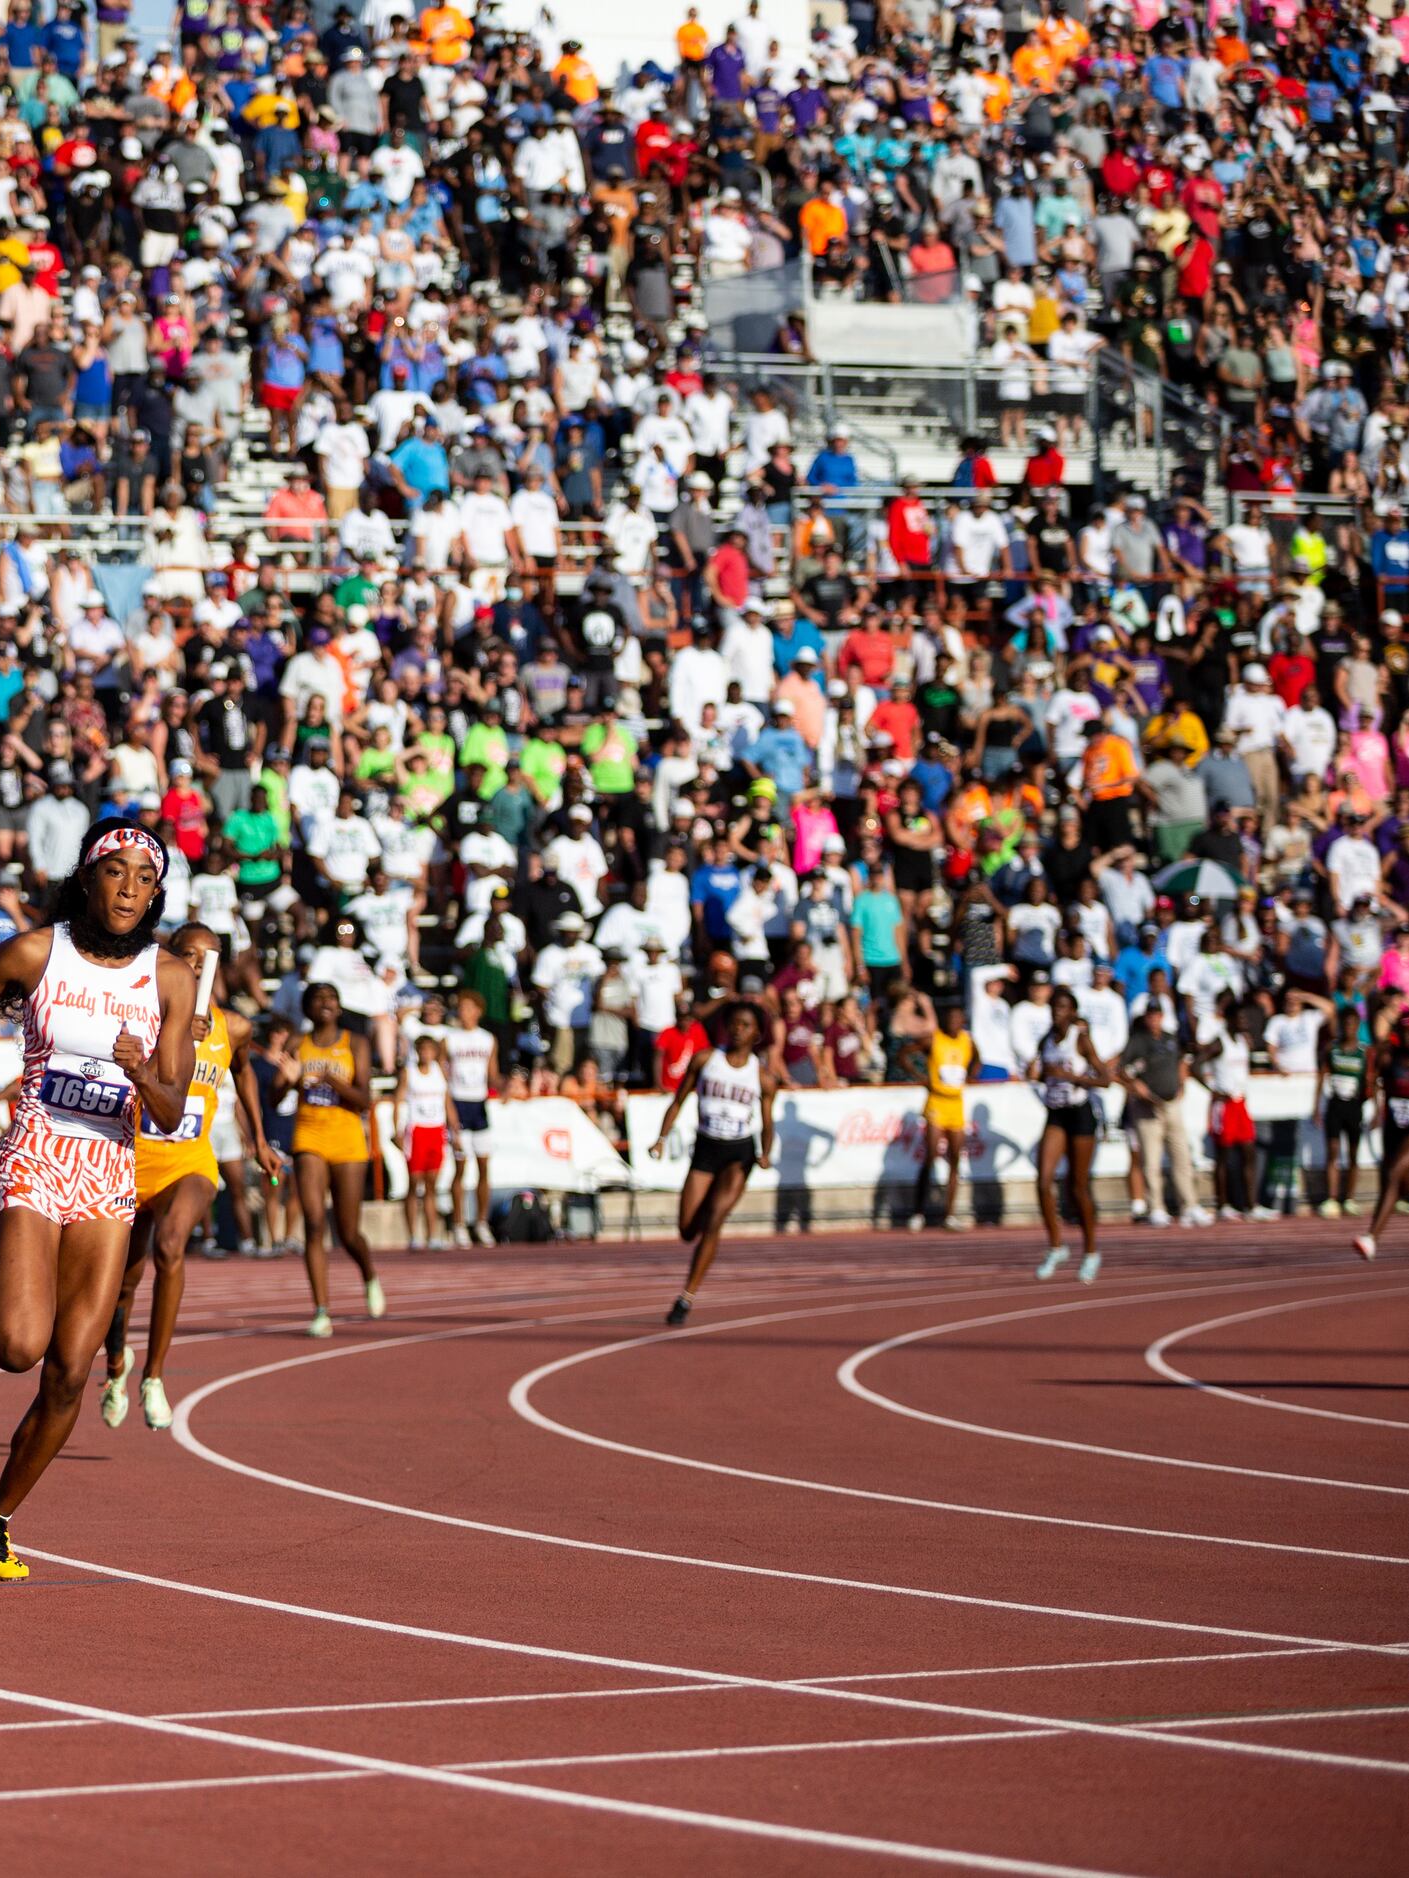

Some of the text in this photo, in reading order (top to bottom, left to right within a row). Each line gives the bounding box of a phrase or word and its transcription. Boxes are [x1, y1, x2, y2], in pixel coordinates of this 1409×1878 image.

[52, 981, 148, 1024] Lady Tigers
[50, 1076, 120, 1114] 1695
